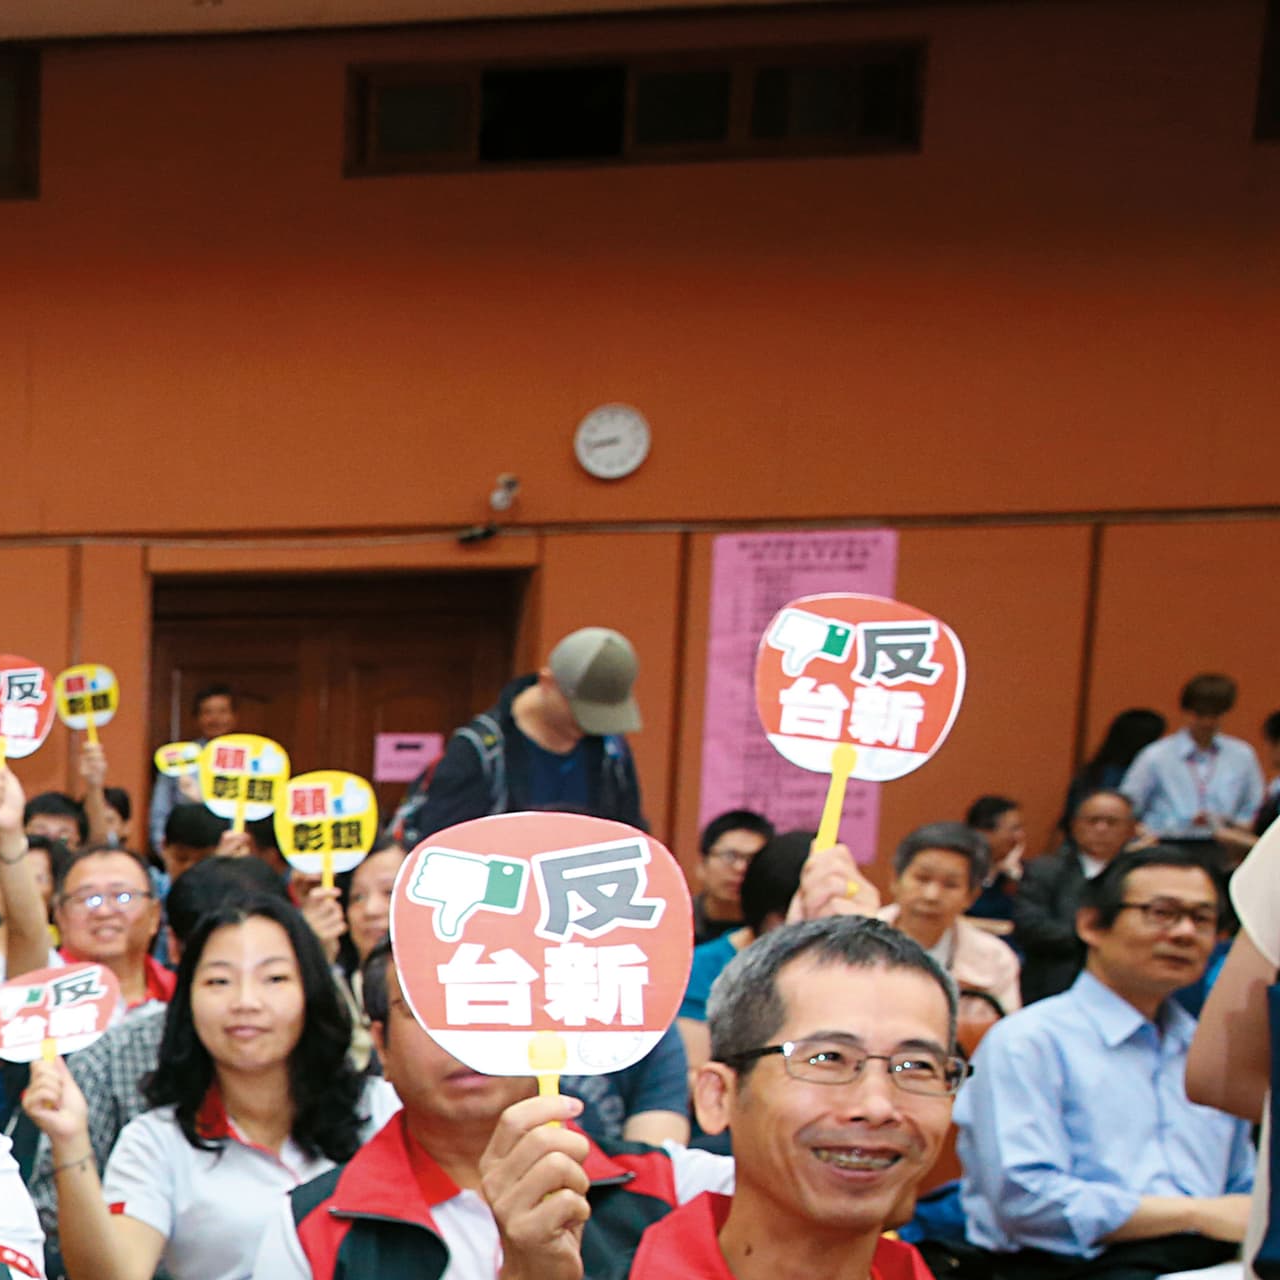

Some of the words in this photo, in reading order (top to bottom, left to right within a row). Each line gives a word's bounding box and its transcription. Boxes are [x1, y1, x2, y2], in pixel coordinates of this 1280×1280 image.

[858, 625, 938, 682] 反
[6, 672, 40, 702] 反
[779, 676, 925, 750] 台新
[538, 843, 658, 937] 反
[52, 969, 102, 1007] 反
[436, 941, 650, 1027] 台新
